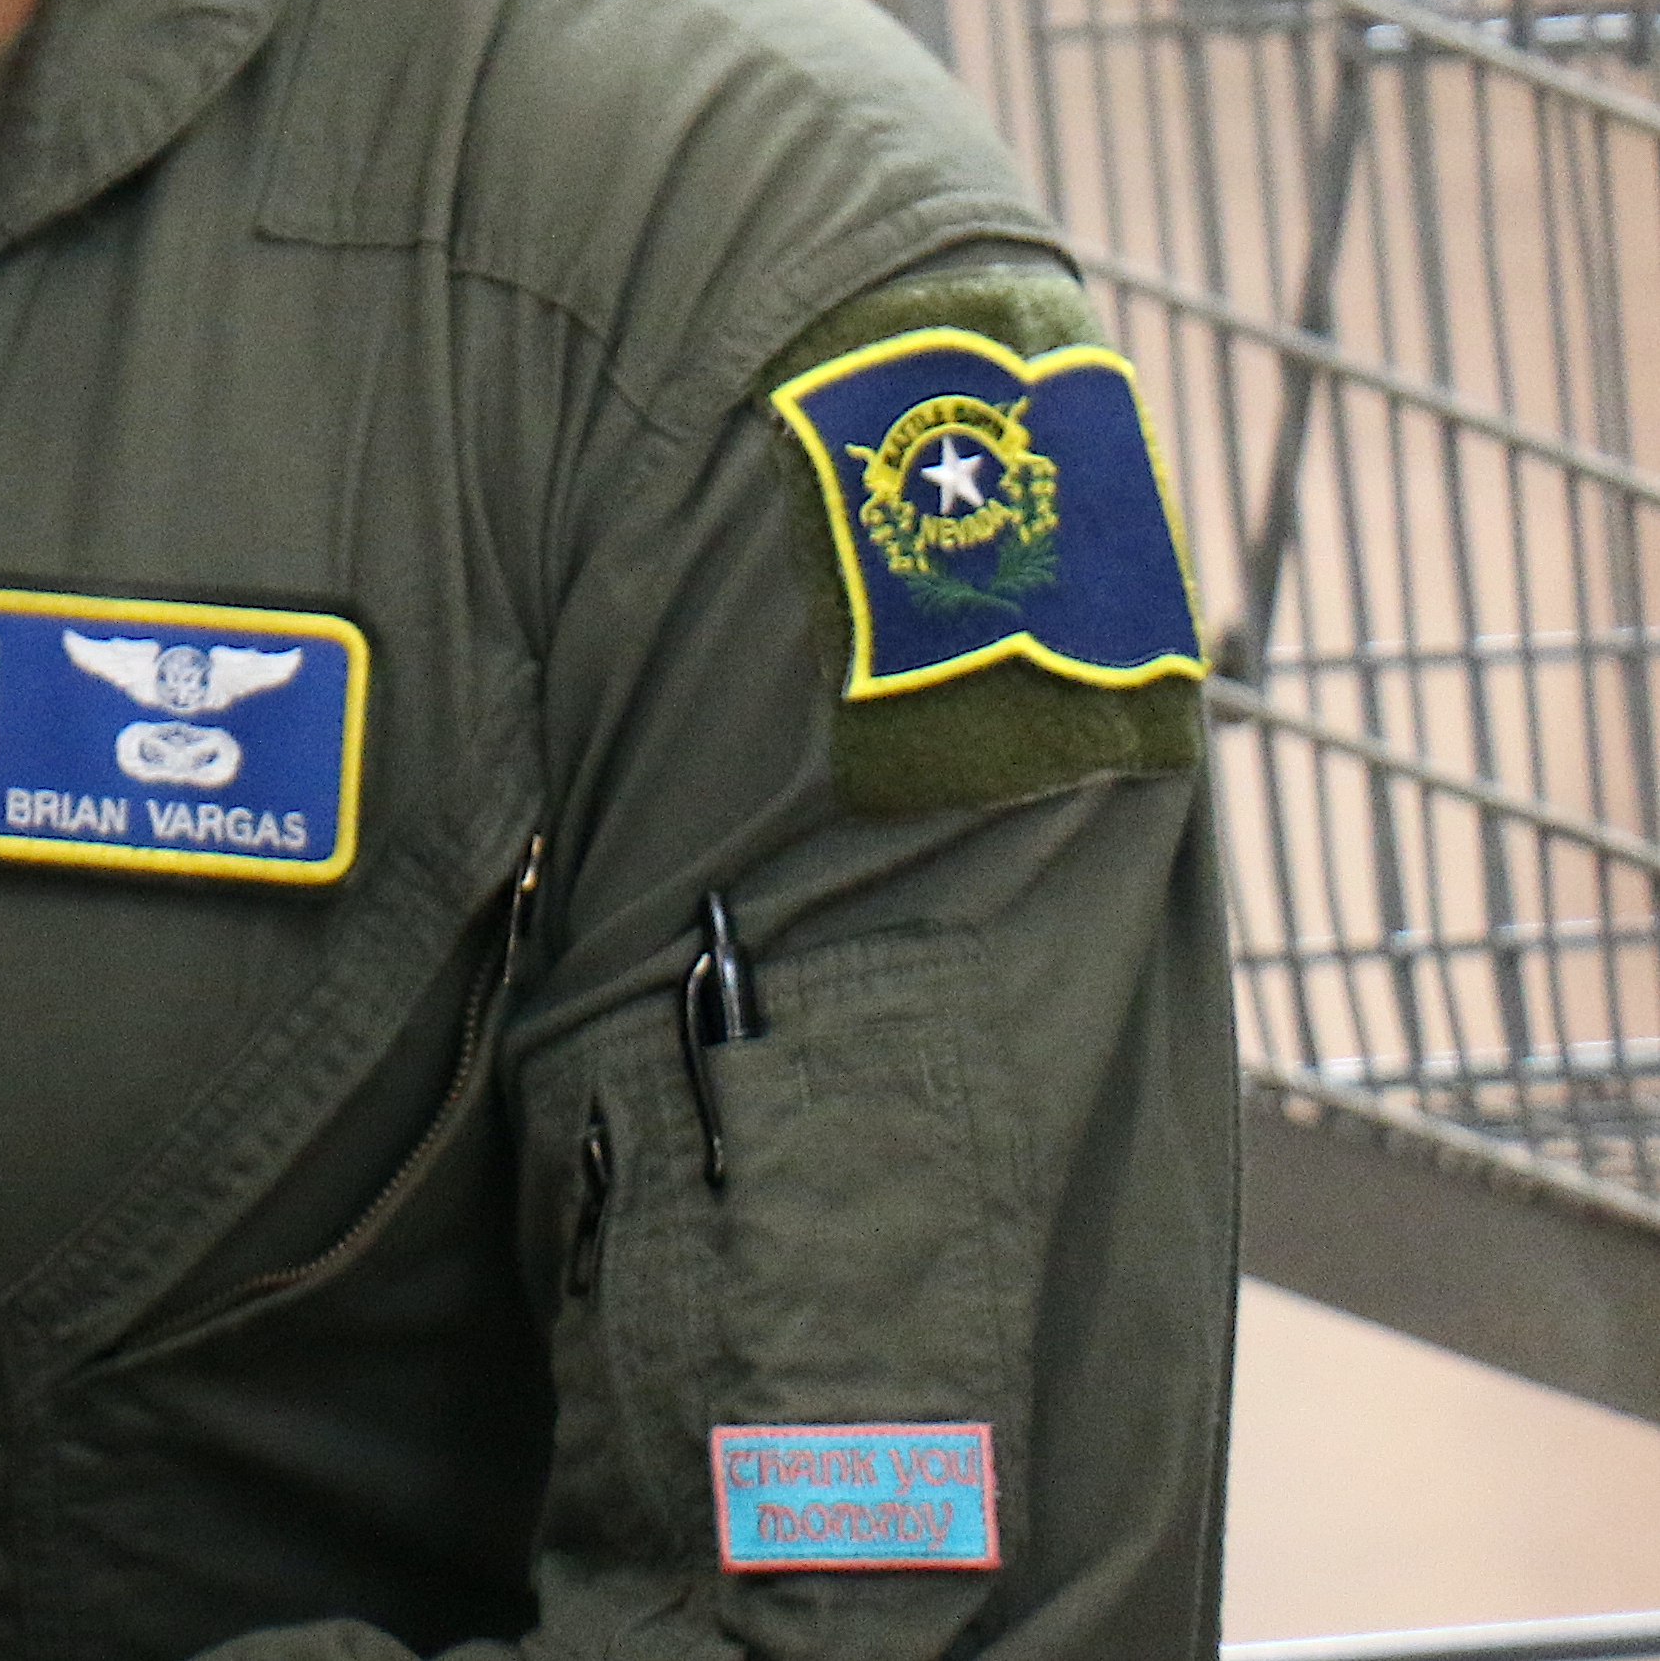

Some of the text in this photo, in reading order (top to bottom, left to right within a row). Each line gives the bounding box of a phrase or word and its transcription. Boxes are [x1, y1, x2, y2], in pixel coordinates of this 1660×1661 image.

[915, 498, 1023, 551] NEVADA
[4, 786, 129, 835] BRIAN
[145, 797, 310, 851] VARGAS
